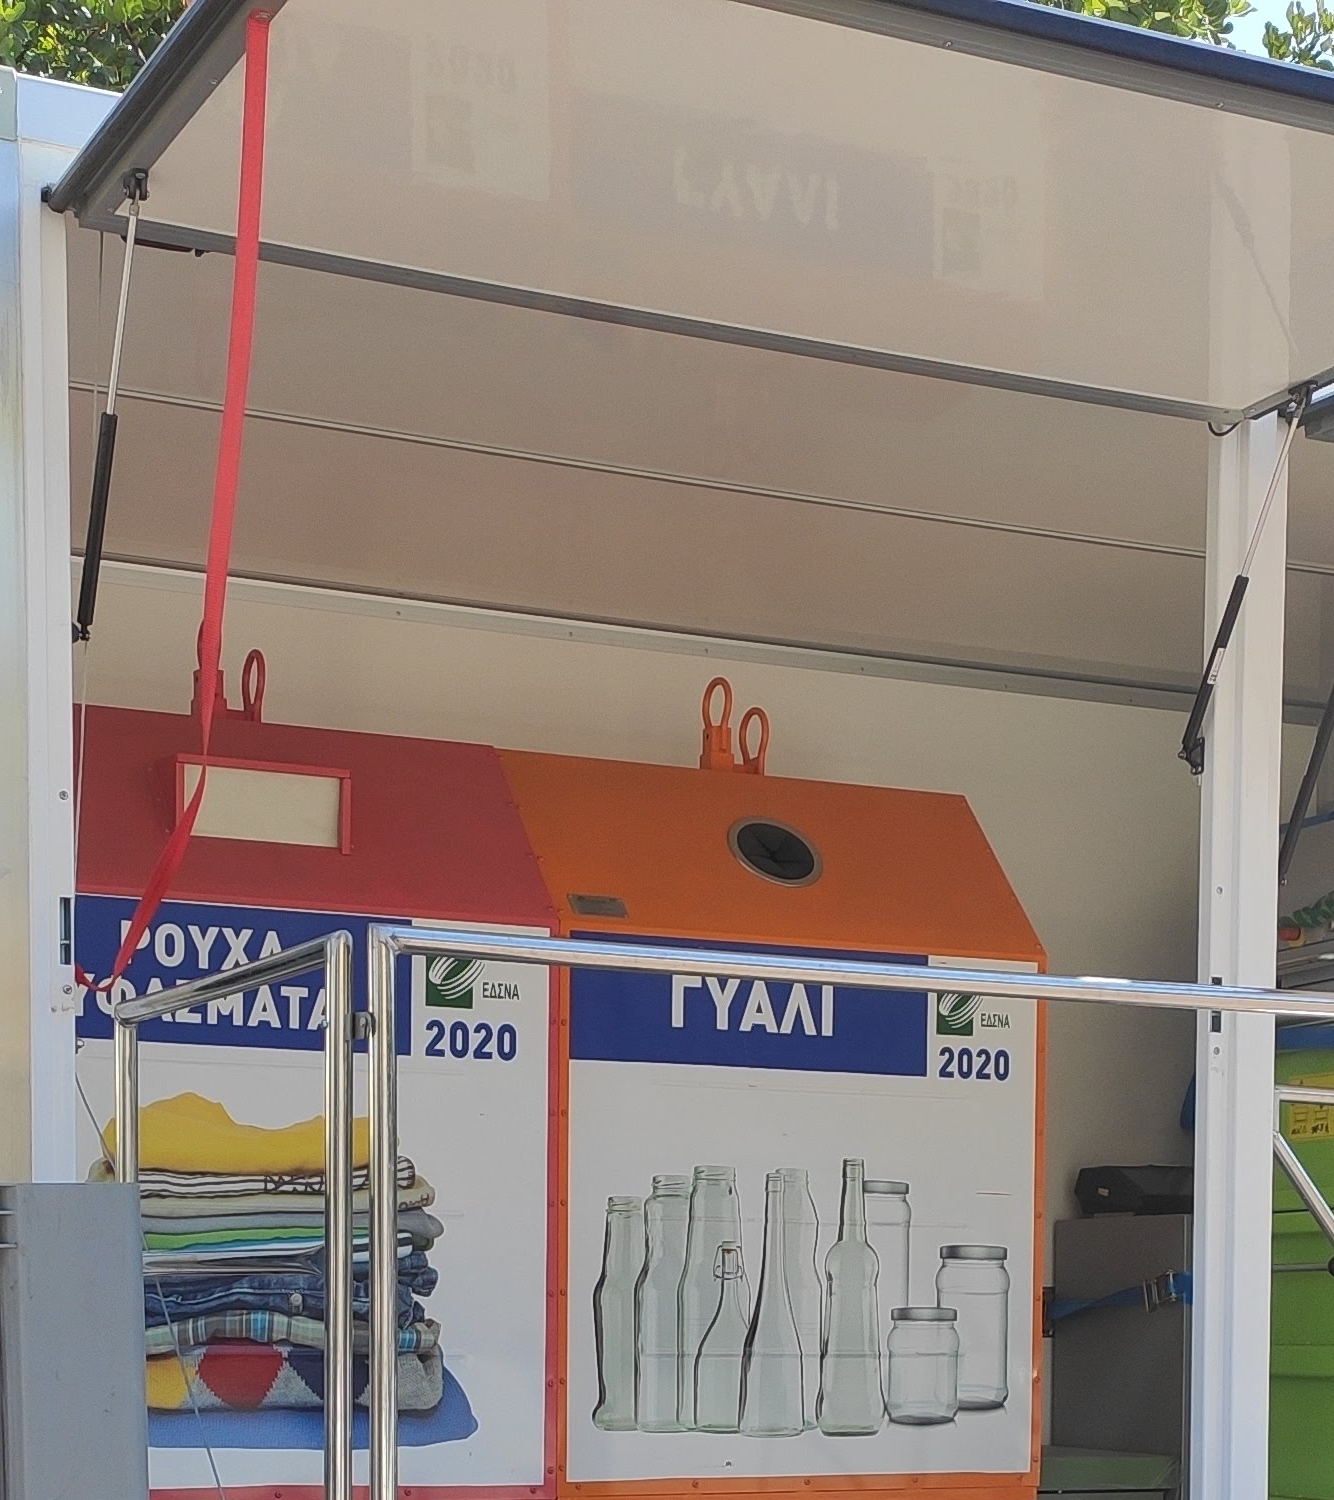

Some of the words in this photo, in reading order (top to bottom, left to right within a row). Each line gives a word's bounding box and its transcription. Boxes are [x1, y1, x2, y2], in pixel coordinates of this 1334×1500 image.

[482, 982, 520, 1001] ΕΔΣΝΑ
[671, 974, 835, 1037] ΓΥΑΛΙ
[980, 1013, 1011, 1029] ΕΔΣΝΑ
[425, 1019, 517, 1061] 2020
[938, 1046, 1010, 1081] 2020
